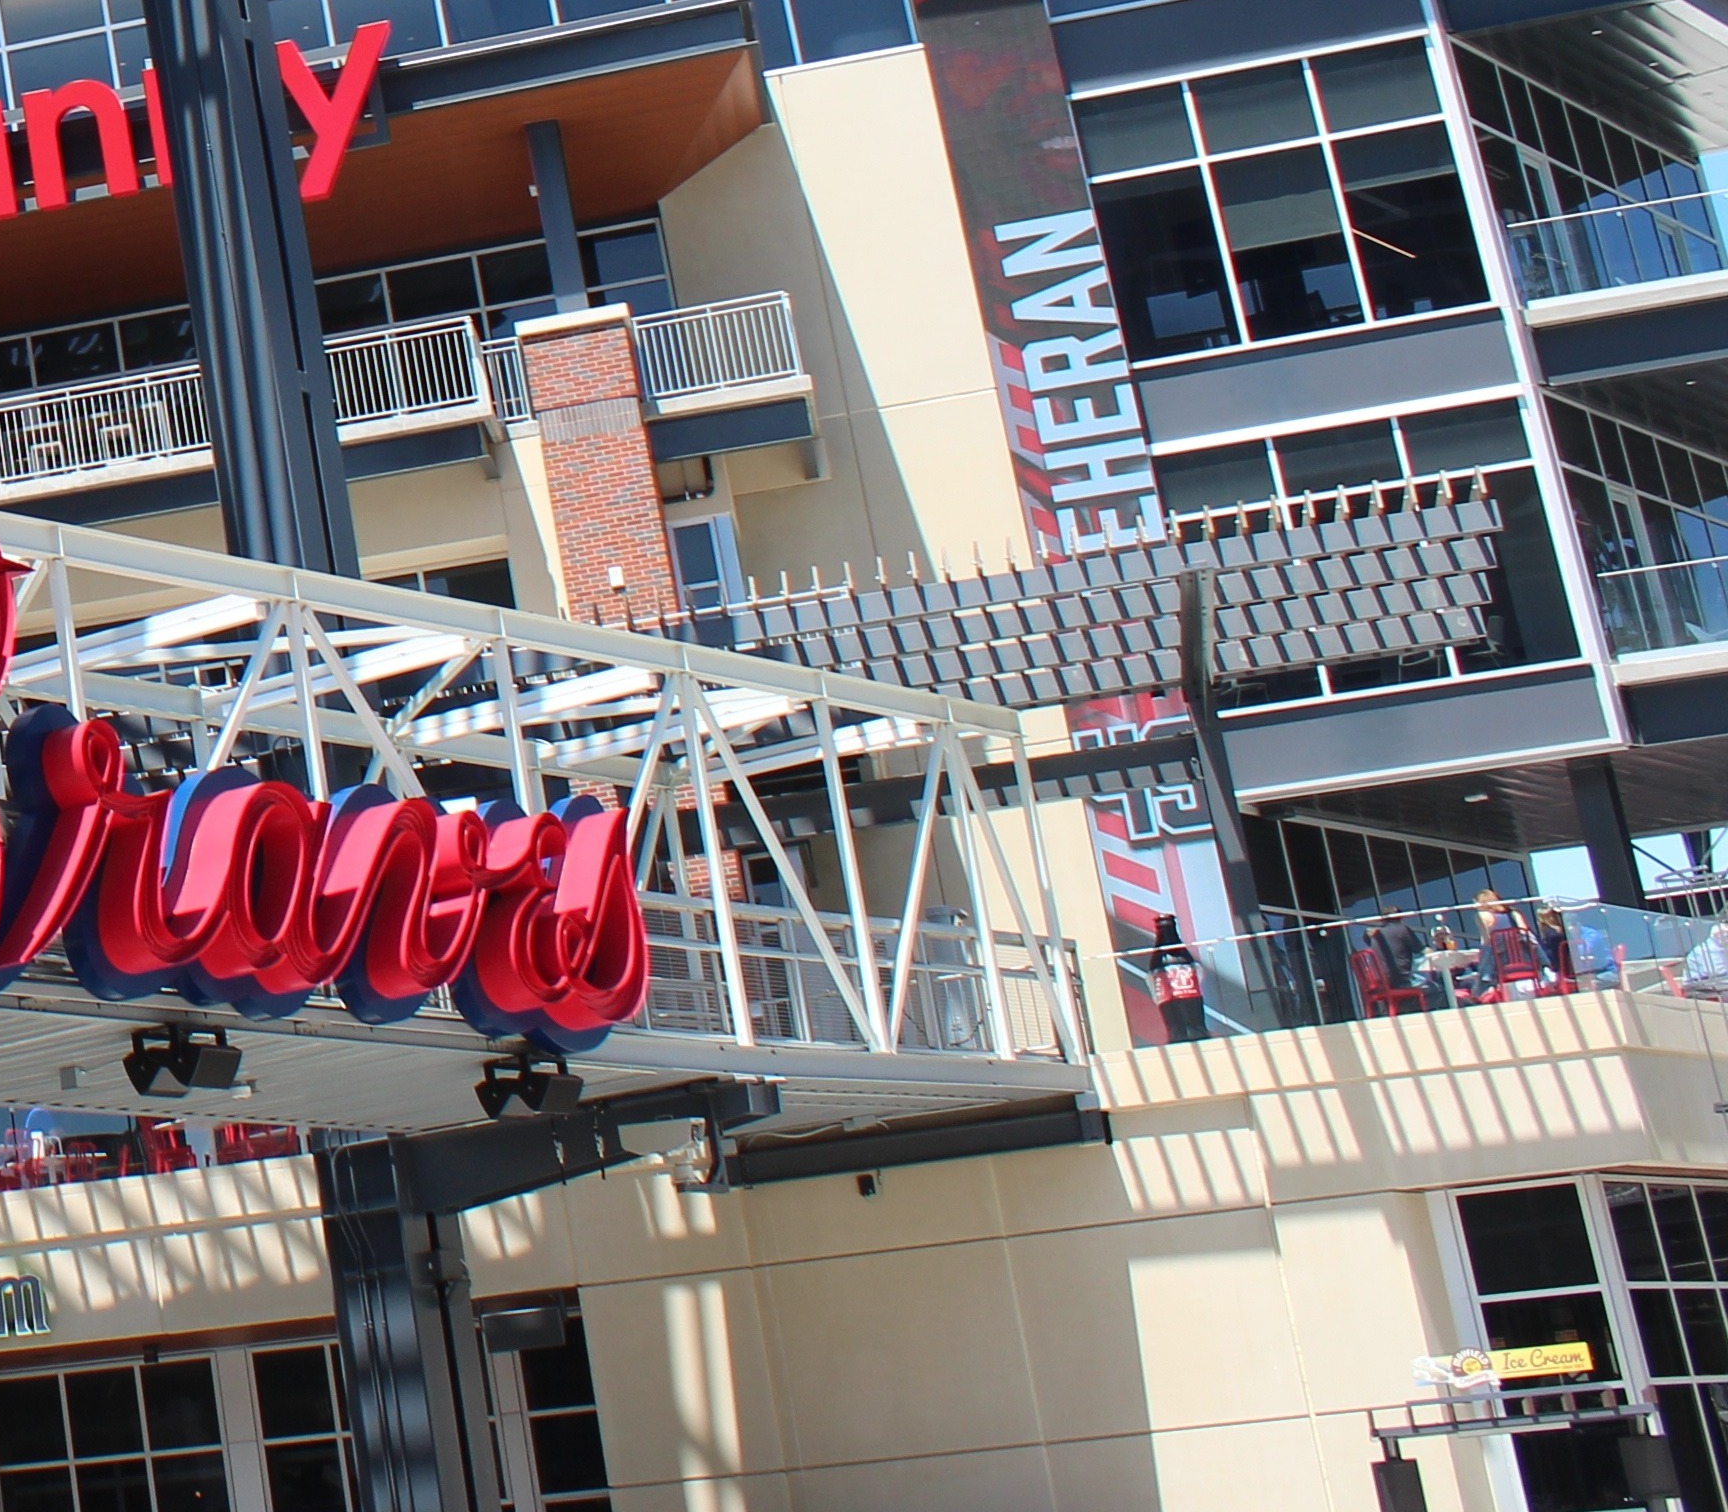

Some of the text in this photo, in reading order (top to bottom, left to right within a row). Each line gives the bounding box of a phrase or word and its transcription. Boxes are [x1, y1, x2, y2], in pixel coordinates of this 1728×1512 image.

[994, 209, 1167, 556] EHERAN
[1501, 1351, 1527, 1371] Ice
[1529, 1348, 1585, 1369] Cream
